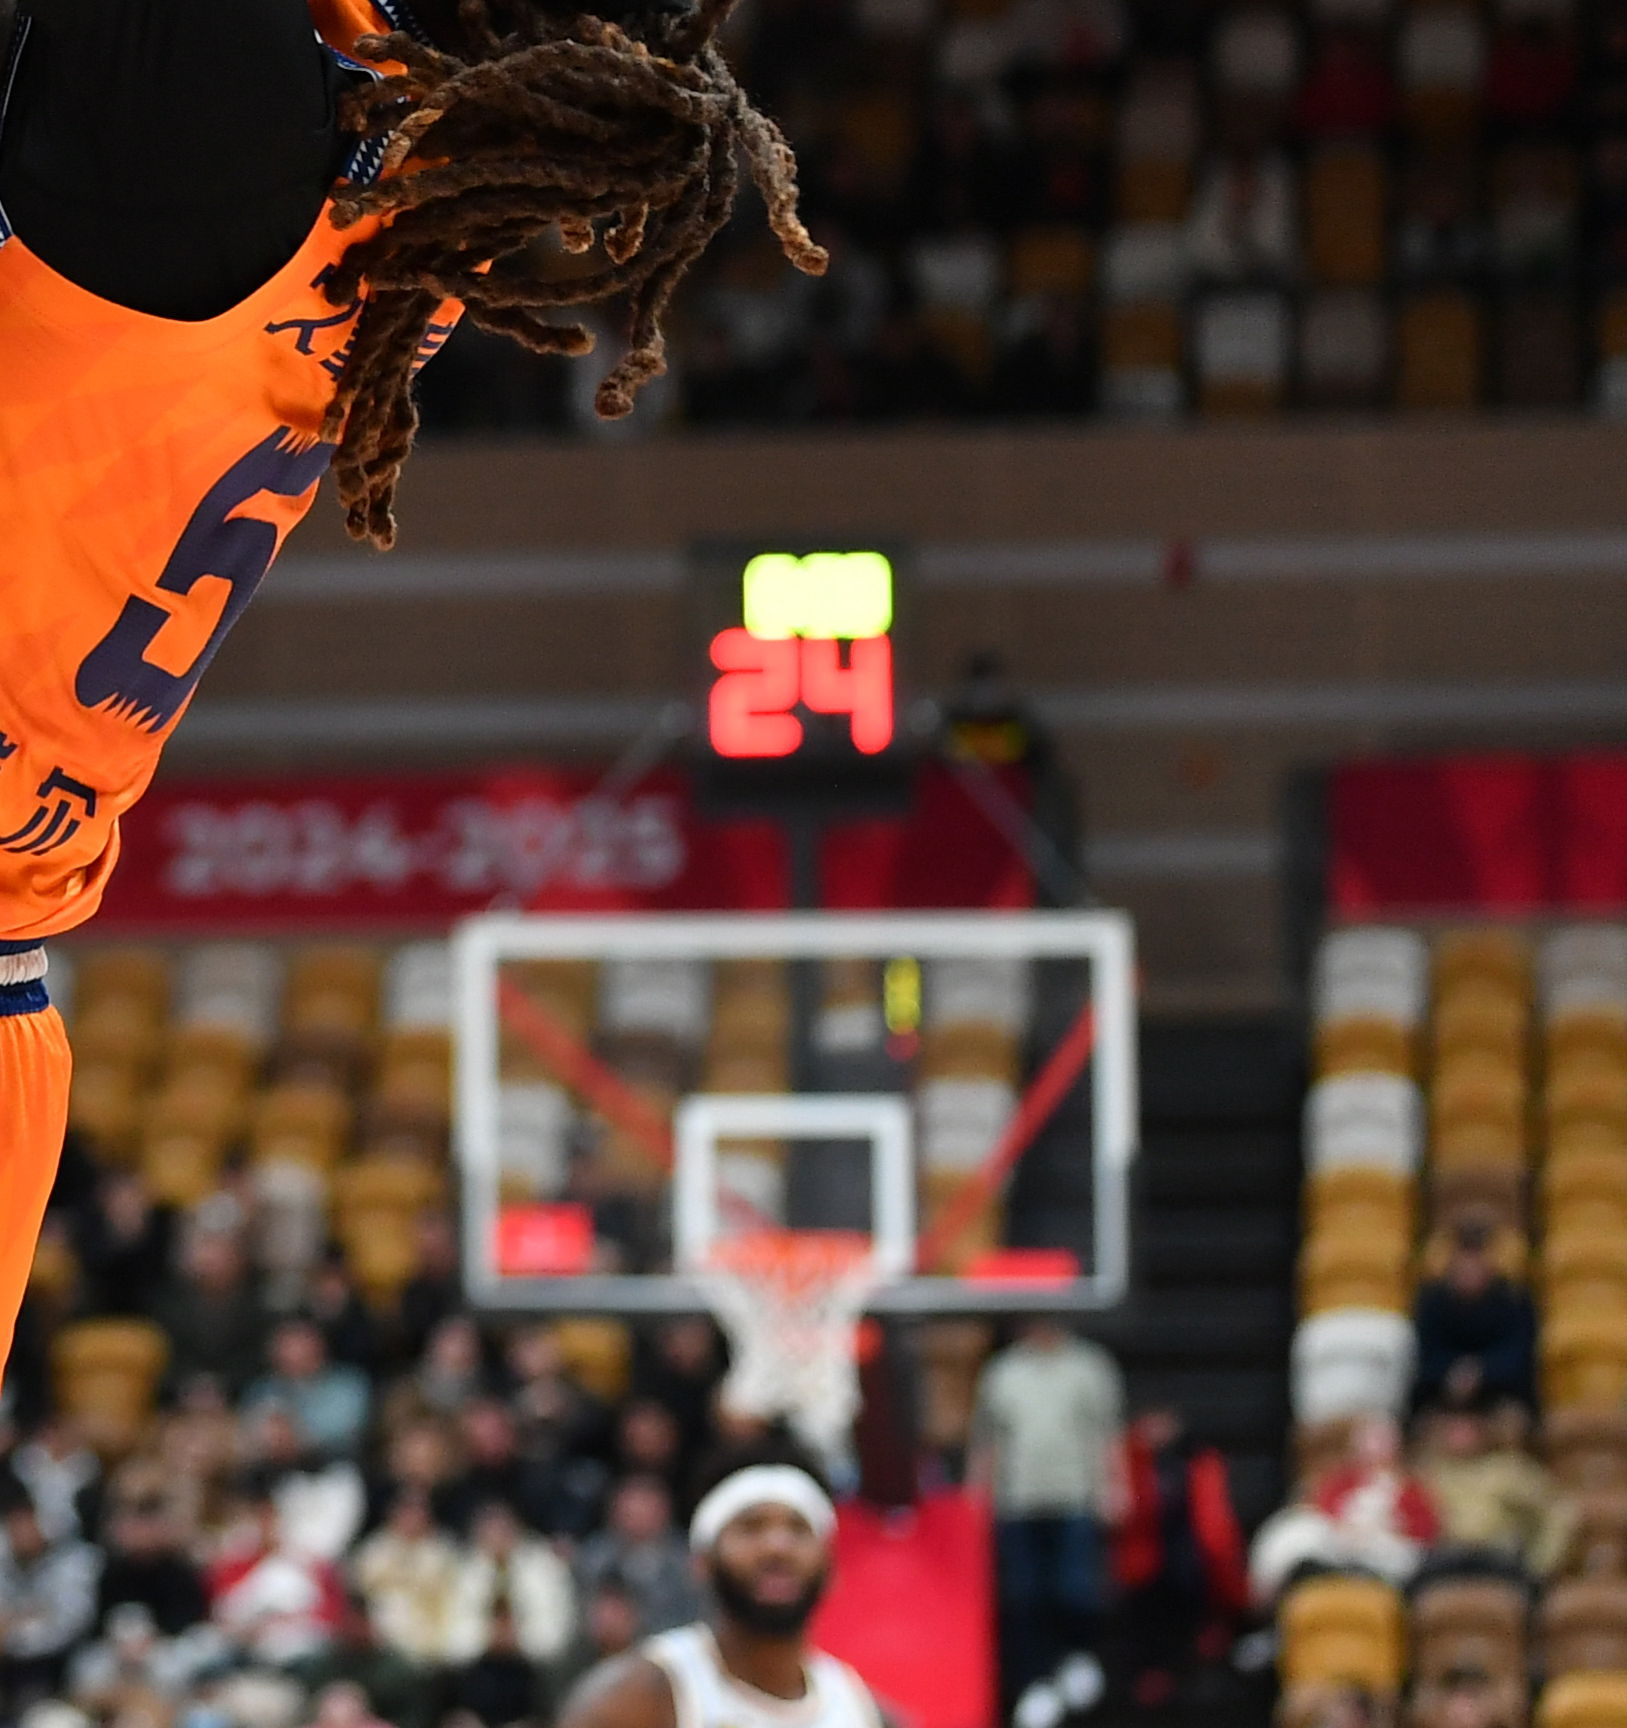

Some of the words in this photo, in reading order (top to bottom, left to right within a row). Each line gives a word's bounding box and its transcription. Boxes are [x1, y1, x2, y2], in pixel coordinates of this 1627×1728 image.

[74, 425, 340, 734] 5
[709, 626, 893, 758] 24
[164, 796, 685, 898] 2024-2025
